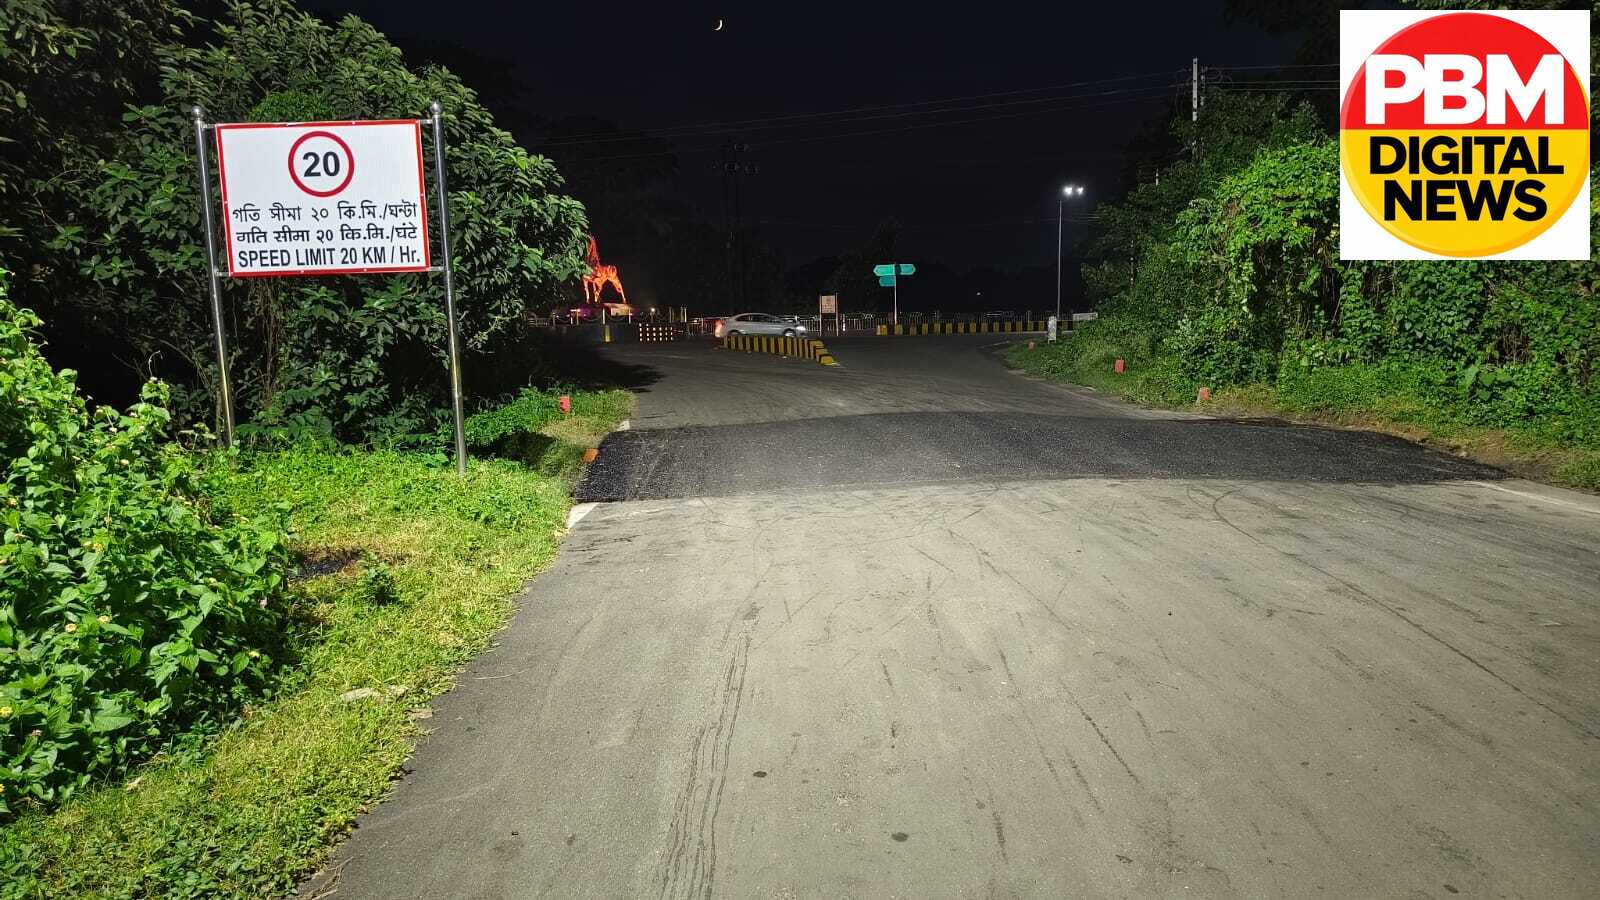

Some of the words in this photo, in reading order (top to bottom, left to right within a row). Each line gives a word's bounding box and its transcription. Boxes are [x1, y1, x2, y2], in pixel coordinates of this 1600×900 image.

[303, 151, 340, 177] 20
[232, 203, 260, 222] গতি
[269, 202, 302, 221] সীমা
[312, 207, 328, 222] ২০
[236, 226, 267, 243] गति
[273, 225, 310, 242] सीमा
[238, 249, 291, 268] SPEED
[296, 247, 335, 266] LIMIT
[340, 247, 358, 265] 20
[362, 246, 386, 264] KM
[399, 245, 421, 263] Hr.
